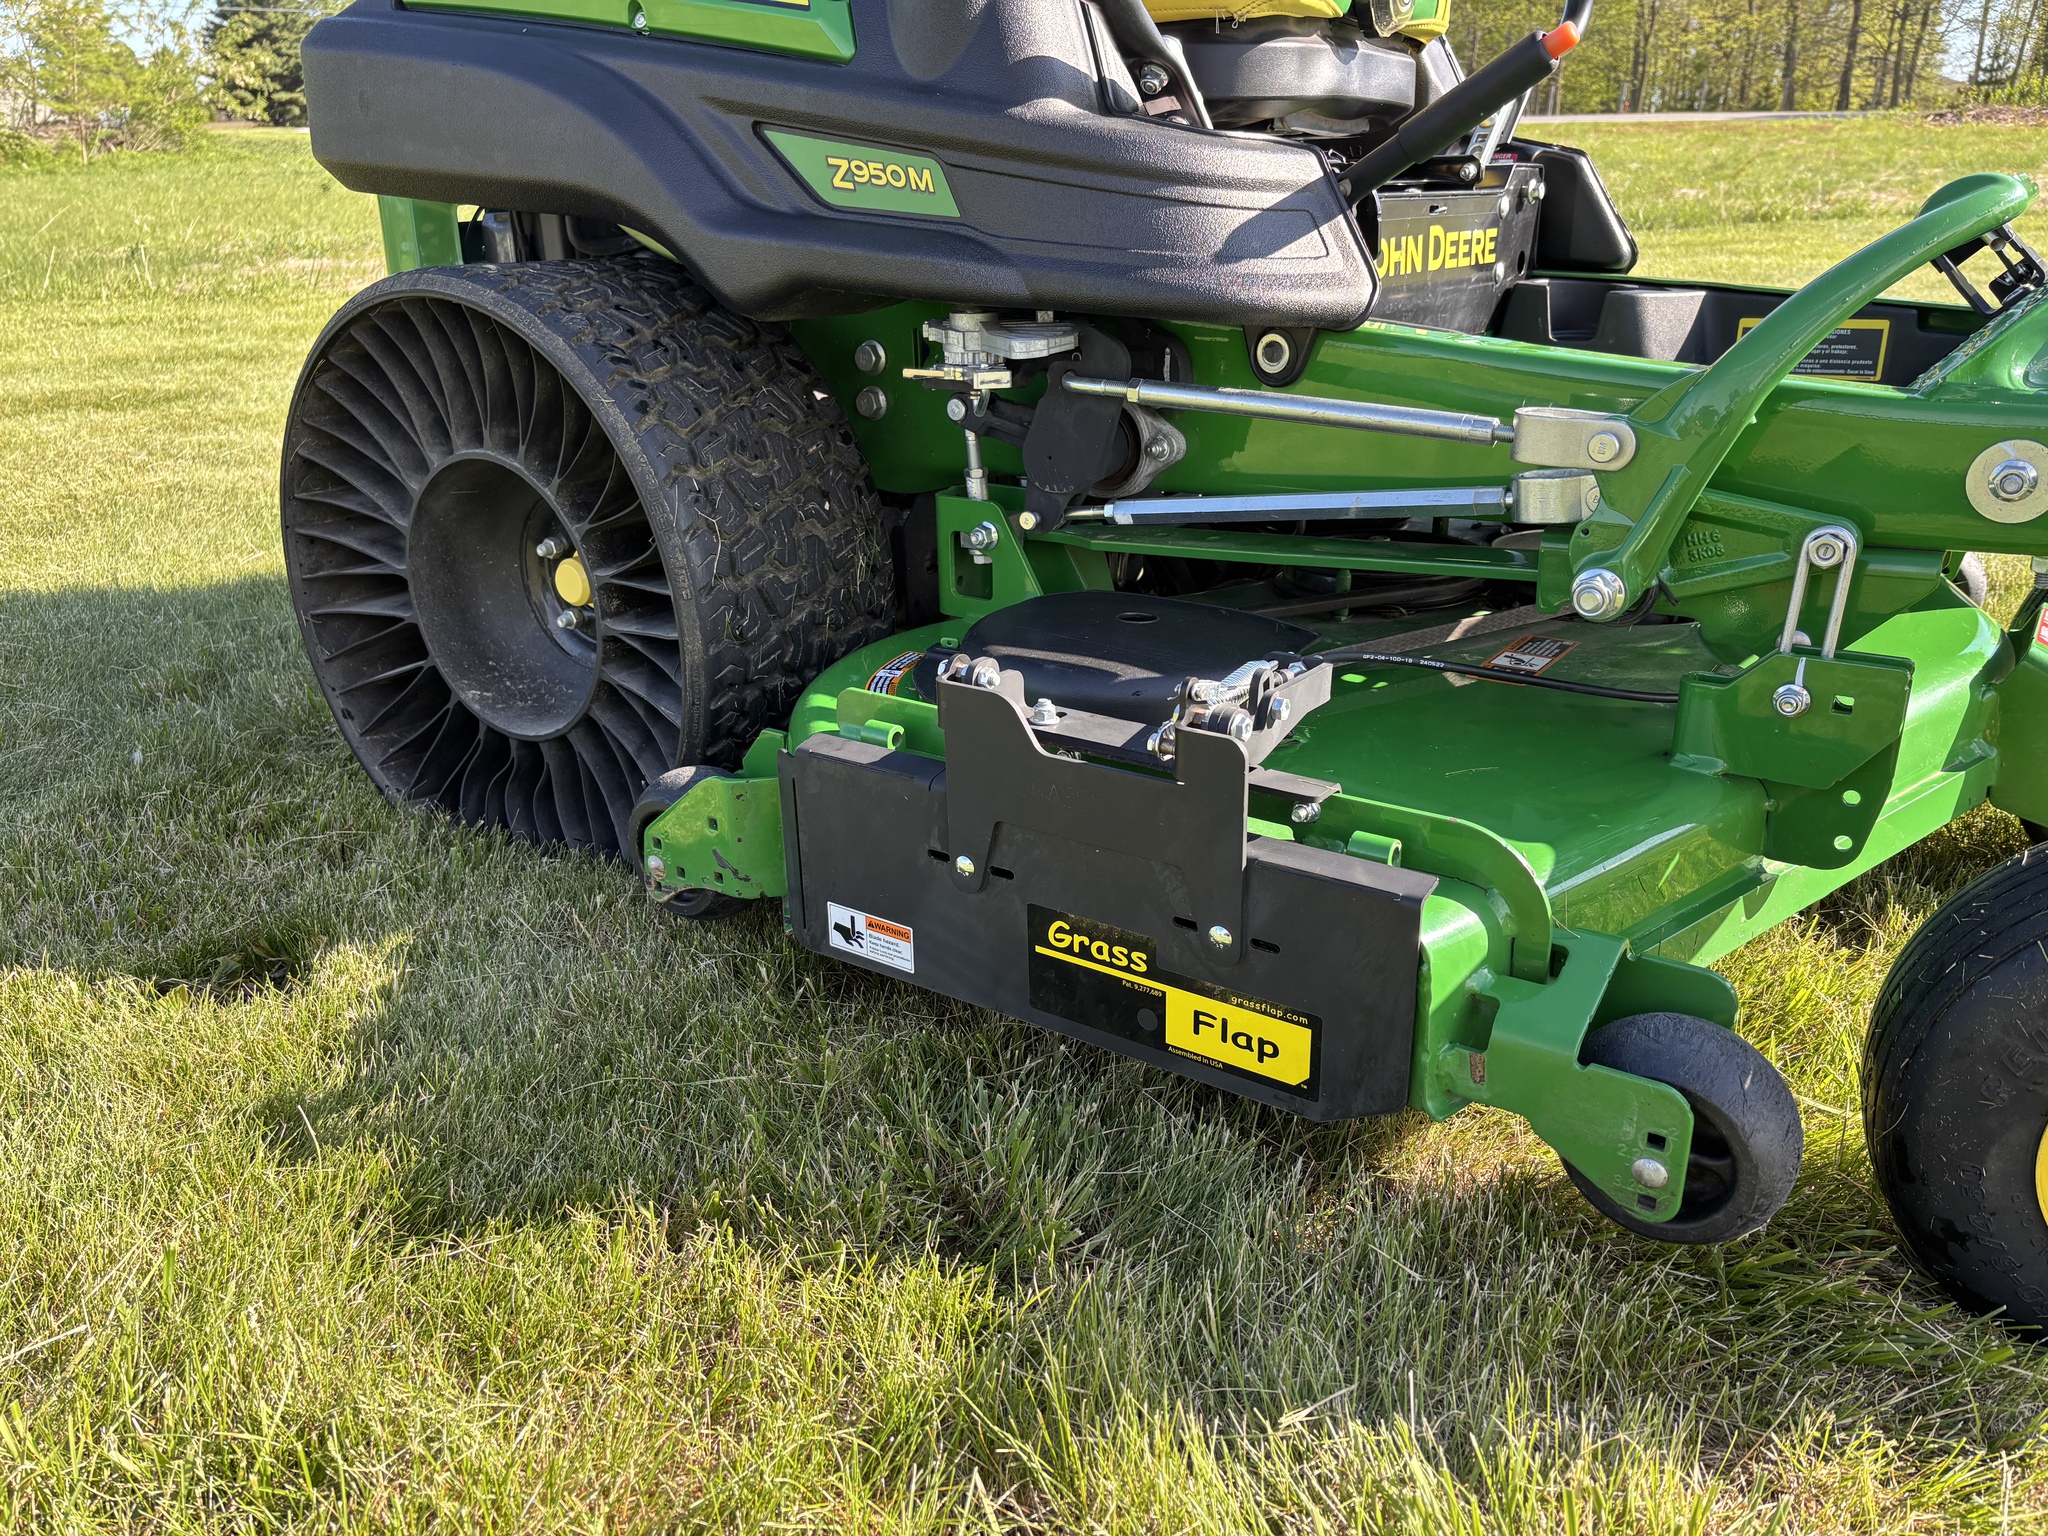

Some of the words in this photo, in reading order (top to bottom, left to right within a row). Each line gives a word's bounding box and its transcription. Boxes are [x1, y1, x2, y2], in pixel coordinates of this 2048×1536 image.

[826, 156, 935, 194] Z950M
[1373, 236, 1424, 280] OHN
[1427, 224, 1498, 272] DEERE
[874, 922, 910, 940] WARNING
[1048, 920, 1148, 973] Grass
[1122, 980, 1133, 988] Pat.
[1231, 996, 1308, 1025] grassflap.com
[1193, 1009, 1280, 1064] Flap
[1168, 1046, 1201, 1061] Assembled
[1210, 1060, 1224, 1069] USA
